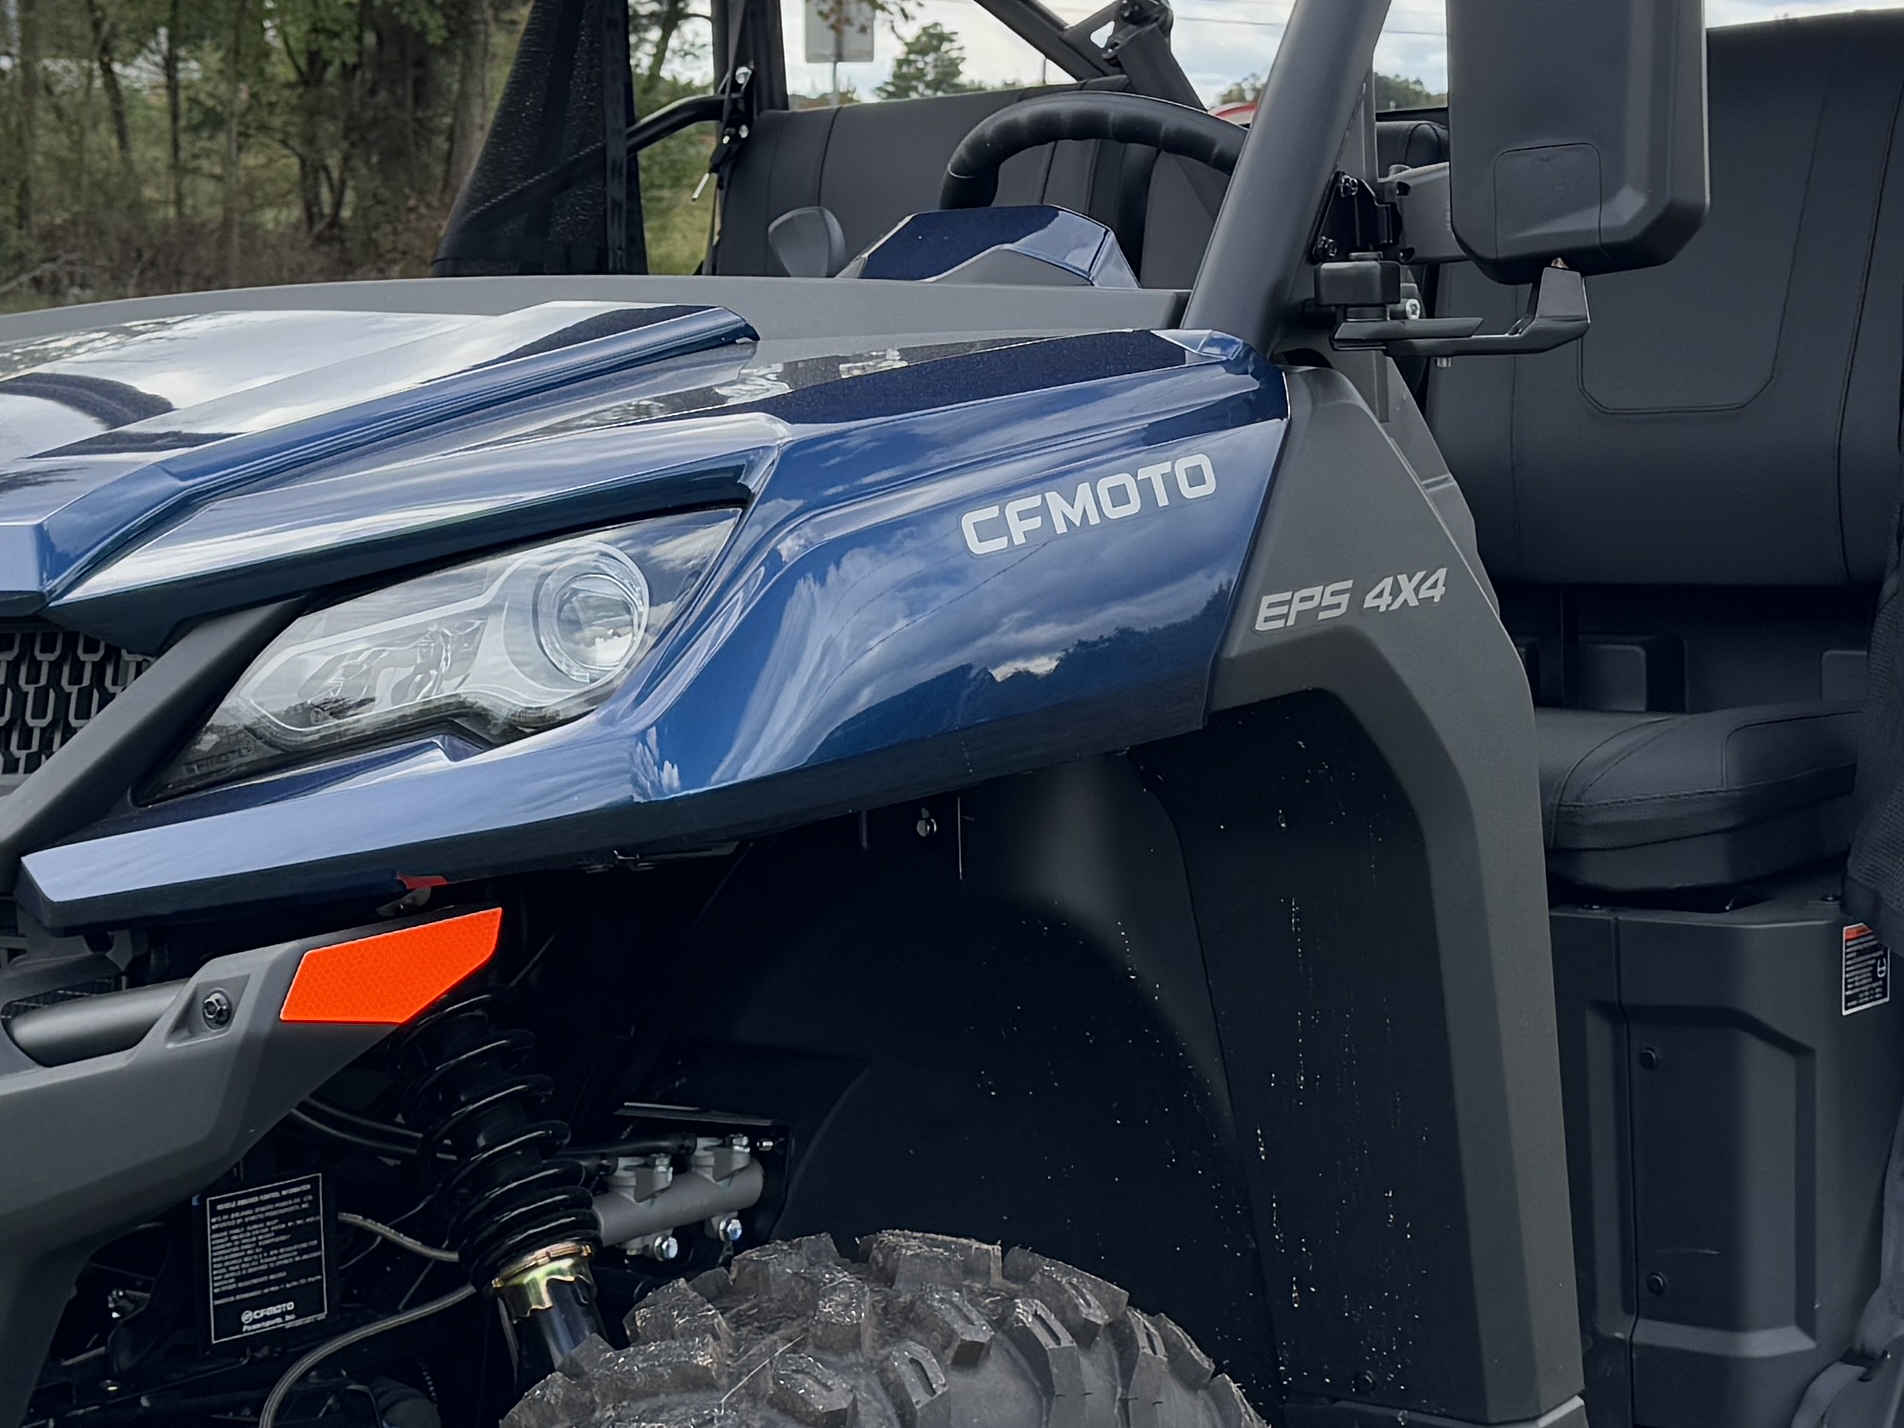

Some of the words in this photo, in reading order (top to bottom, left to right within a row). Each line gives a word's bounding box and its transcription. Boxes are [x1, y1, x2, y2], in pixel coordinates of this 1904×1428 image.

[960, 452, 1217, 556] CFMOTO
[1253, 578, 1353, 632] EPS
[1361, 566, 1449, 614] 4X4
